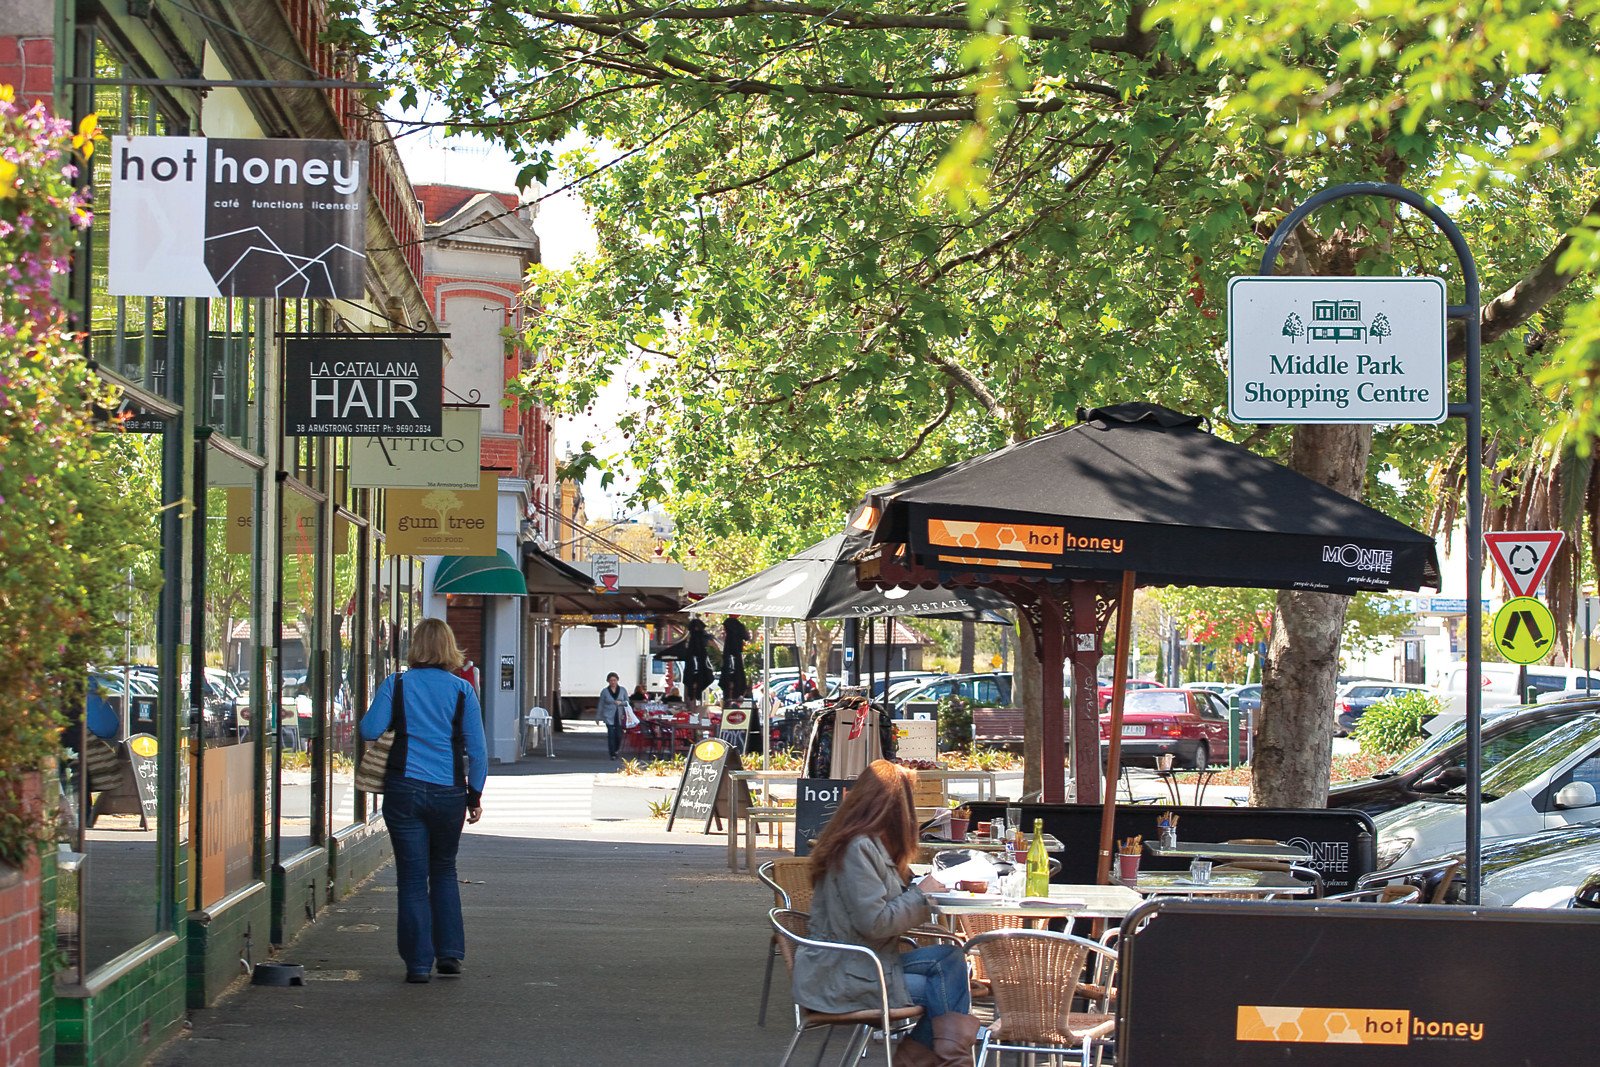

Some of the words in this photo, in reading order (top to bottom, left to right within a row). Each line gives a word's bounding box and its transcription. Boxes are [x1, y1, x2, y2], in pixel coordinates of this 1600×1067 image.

[121, 147, 197, 182] hot
[214, 148, 359, 195] honey
[213, 199, 240, 208] café
[251, 200, 304, 210] functions
[311, 200, 359, 211] licensed
[310, 361, 329, 376] LA
[334, 361, 419, 377] CATALANA
[1269, 354, 1349, 375] Middle
[1356, 354, 1405, 375] Park
[310, 379, 420, 418] HAIR
[1244, 381, 1349, 409] Shopping
[1357, 382, 1429, 402] Centre
[296, 424, 305, 433] 38
[308, 424, 353, 433] ARMSTRONG
[355, 424, 380, 433] STREET
[383, 424, 394, 433] Ph:
[396, 424, 414, 433] 9690
[415, 424, 431, 434] 2834
[398, 515, 438, 531] gum
[448, 515, 485, 530] tree
[1029, 531, 1060, 546] hot
[1066, 533, 1124, 553] honey
[1322, 543, 1393, 568] MONTE
[1357, 564, 1392, 574] COFFEE
[913, 598, 969, 612] ESTATE
[804, 786, 839, 801] hot
[1308, 861, 1349, 873] COFFEE
[1365, 1016, 1403, 1033] hot
[1413, 1017, 1485, 1040] honey
